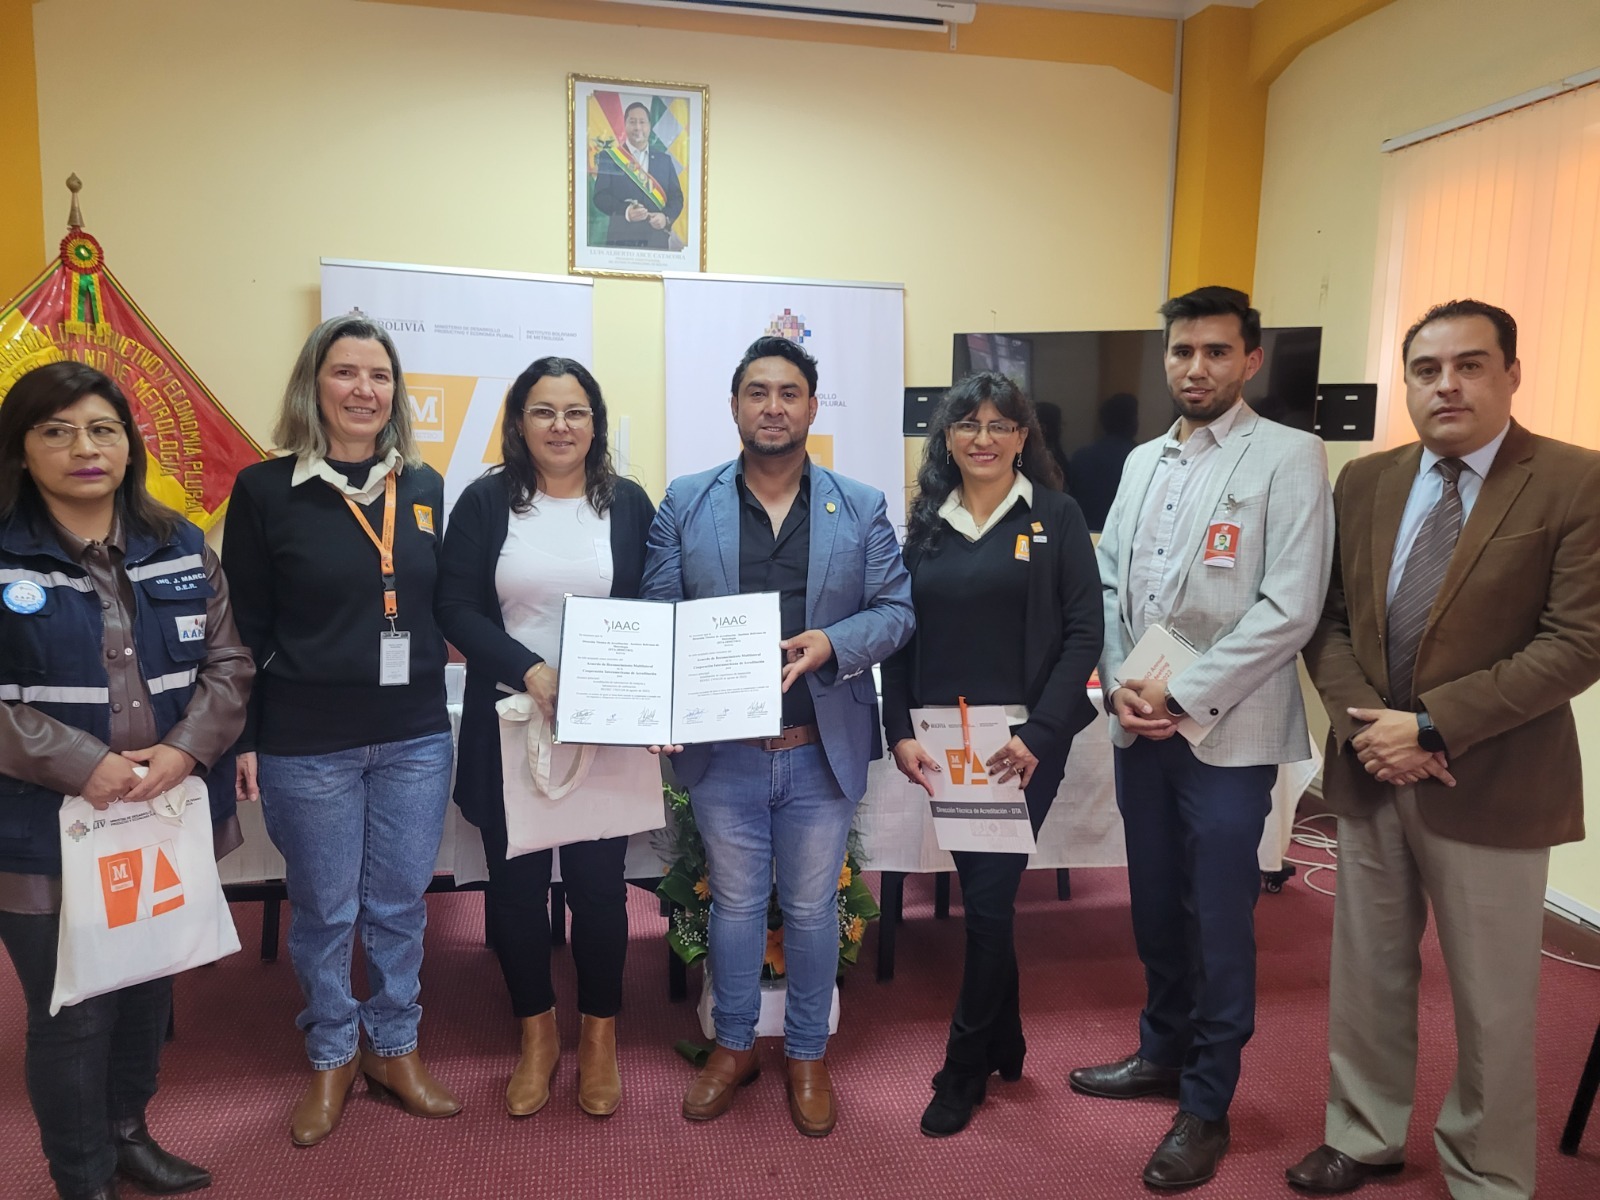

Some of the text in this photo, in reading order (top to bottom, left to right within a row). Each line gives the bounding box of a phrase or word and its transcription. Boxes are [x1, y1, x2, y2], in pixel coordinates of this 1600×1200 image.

[820, 400, 848, 408] PLURAL
[611, 620, 640, 632] IAAC
[719, 615, 747, 627] IAAC
[112, 863, 128, 881] M
